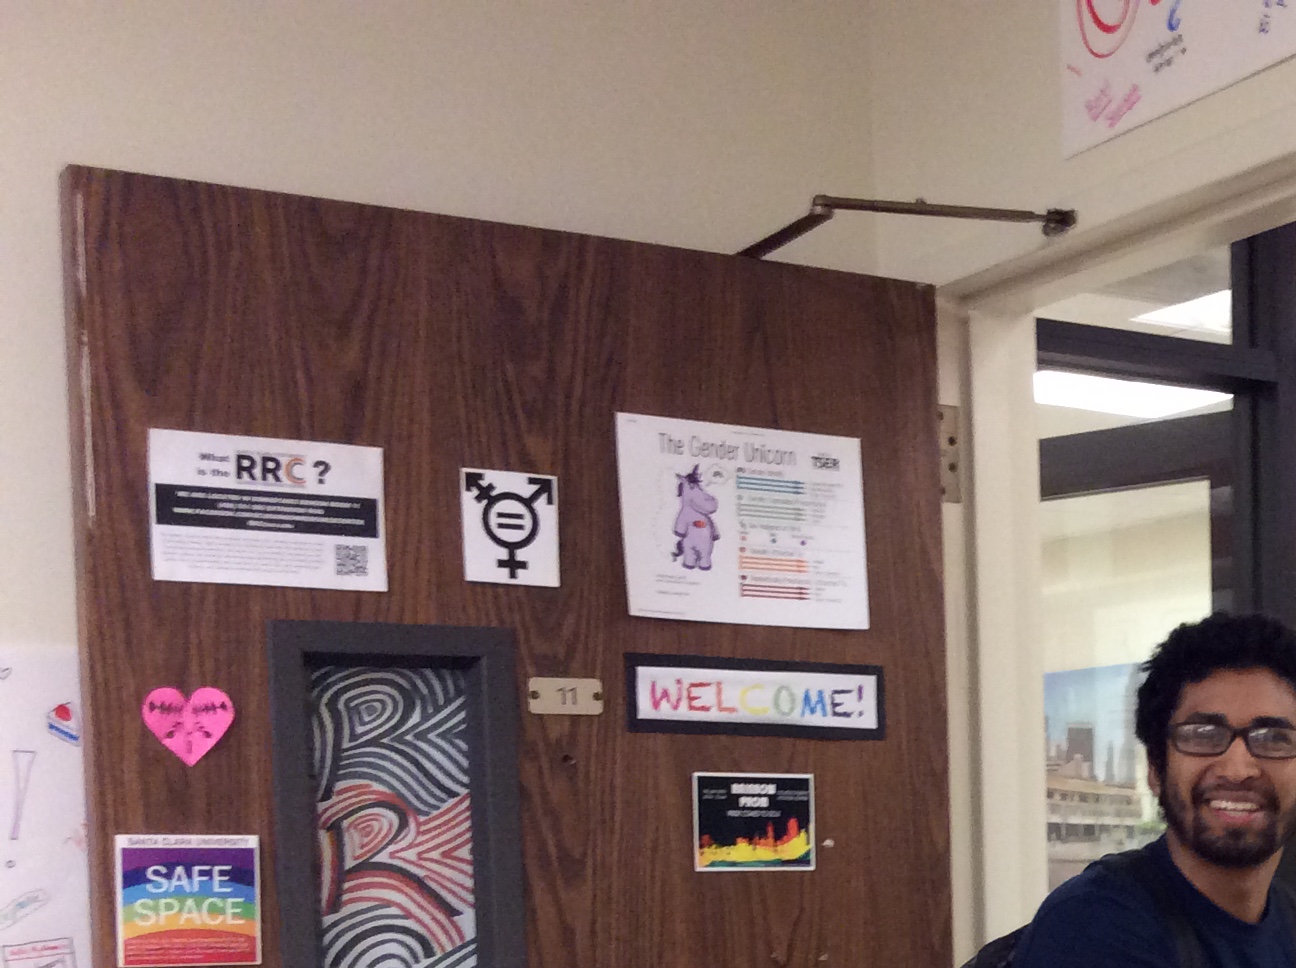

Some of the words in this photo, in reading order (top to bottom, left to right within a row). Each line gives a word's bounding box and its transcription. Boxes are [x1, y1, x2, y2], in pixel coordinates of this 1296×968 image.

[658, 432, 684, 455] The
[689, 435, 740, 460] Gender
[743, 441, 797, 466] Unicorn
[211, 467, 231, 478] the
[556, 686, 579, 706] 11
[650, 678, 866, 718] WELCOME!
[128, 838, 158, 846] SANTA
[162, 838, 192, 846] CLARA
[196, 838, 250, 846] UNIVERSITY
[145, 864, 234, 894] SAFE
[133, 896, 246, 927] SPACE
